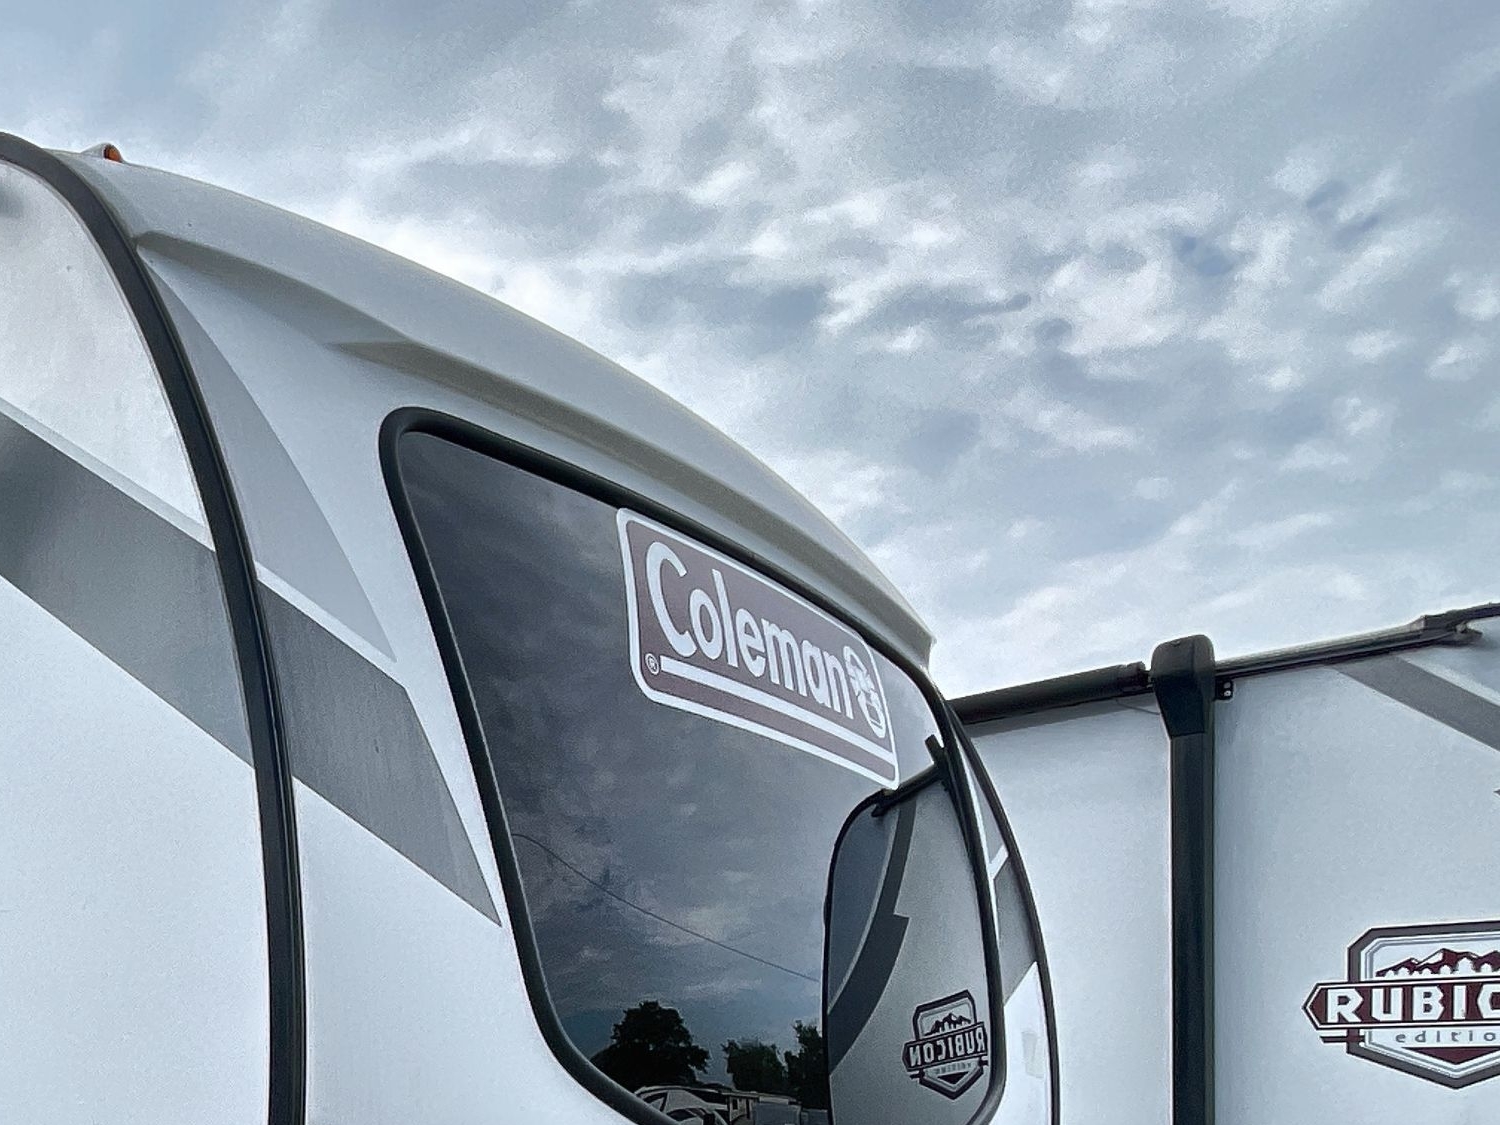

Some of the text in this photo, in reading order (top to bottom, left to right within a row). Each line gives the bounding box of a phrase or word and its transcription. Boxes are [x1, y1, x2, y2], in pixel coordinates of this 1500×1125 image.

[646, 541, 854, 720] Coleman
[1327, 984, 1500, 1022] RUBIC
[1395, 1030, 1497, 1043] editio
